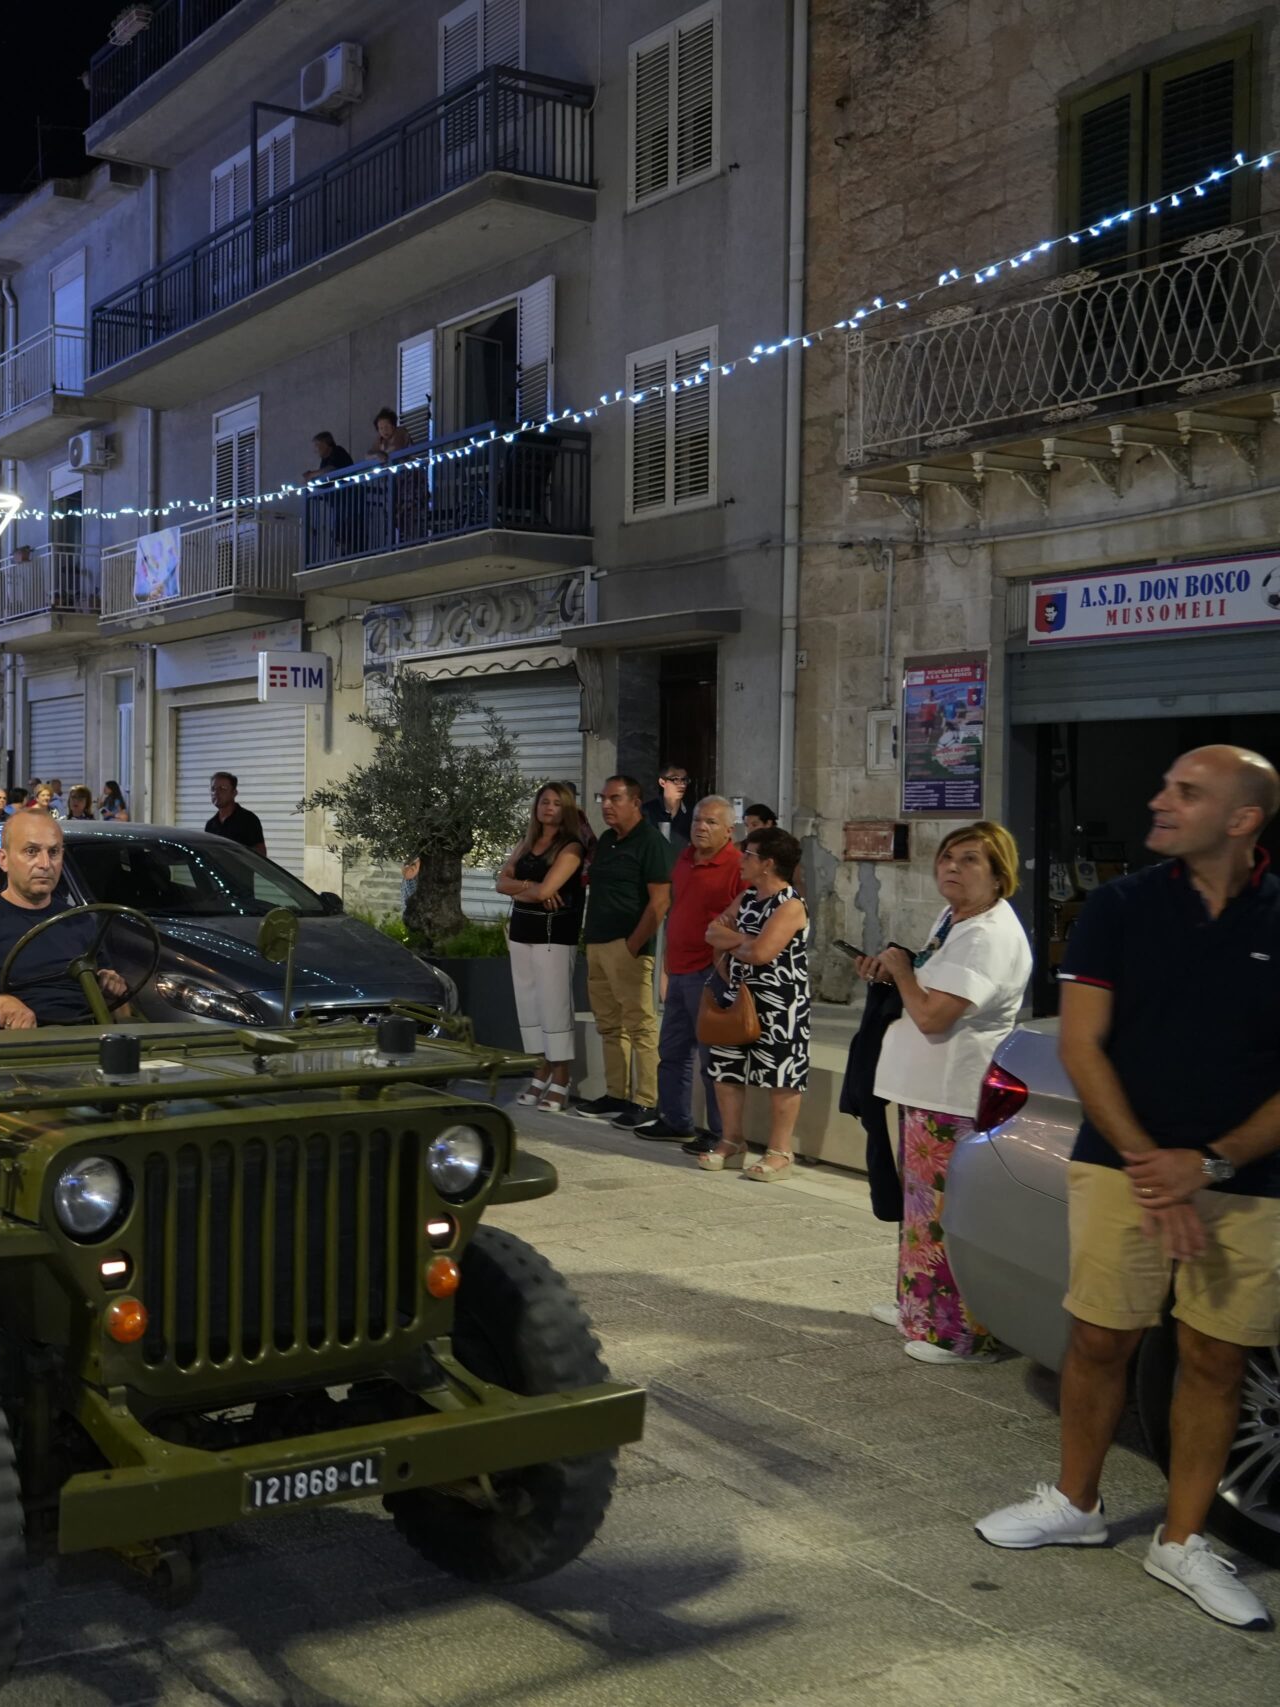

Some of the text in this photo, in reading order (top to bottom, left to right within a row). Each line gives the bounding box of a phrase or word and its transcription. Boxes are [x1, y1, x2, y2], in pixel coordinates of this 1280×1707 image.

[1080, 569, 1251, 608] A.S.D. DON BOSCO
[1106, 598, 1227, 626] MUSSOMELI
[290, 667, 323, 688] TIM
[255, 1458, 379, 1507] 121868 CL
